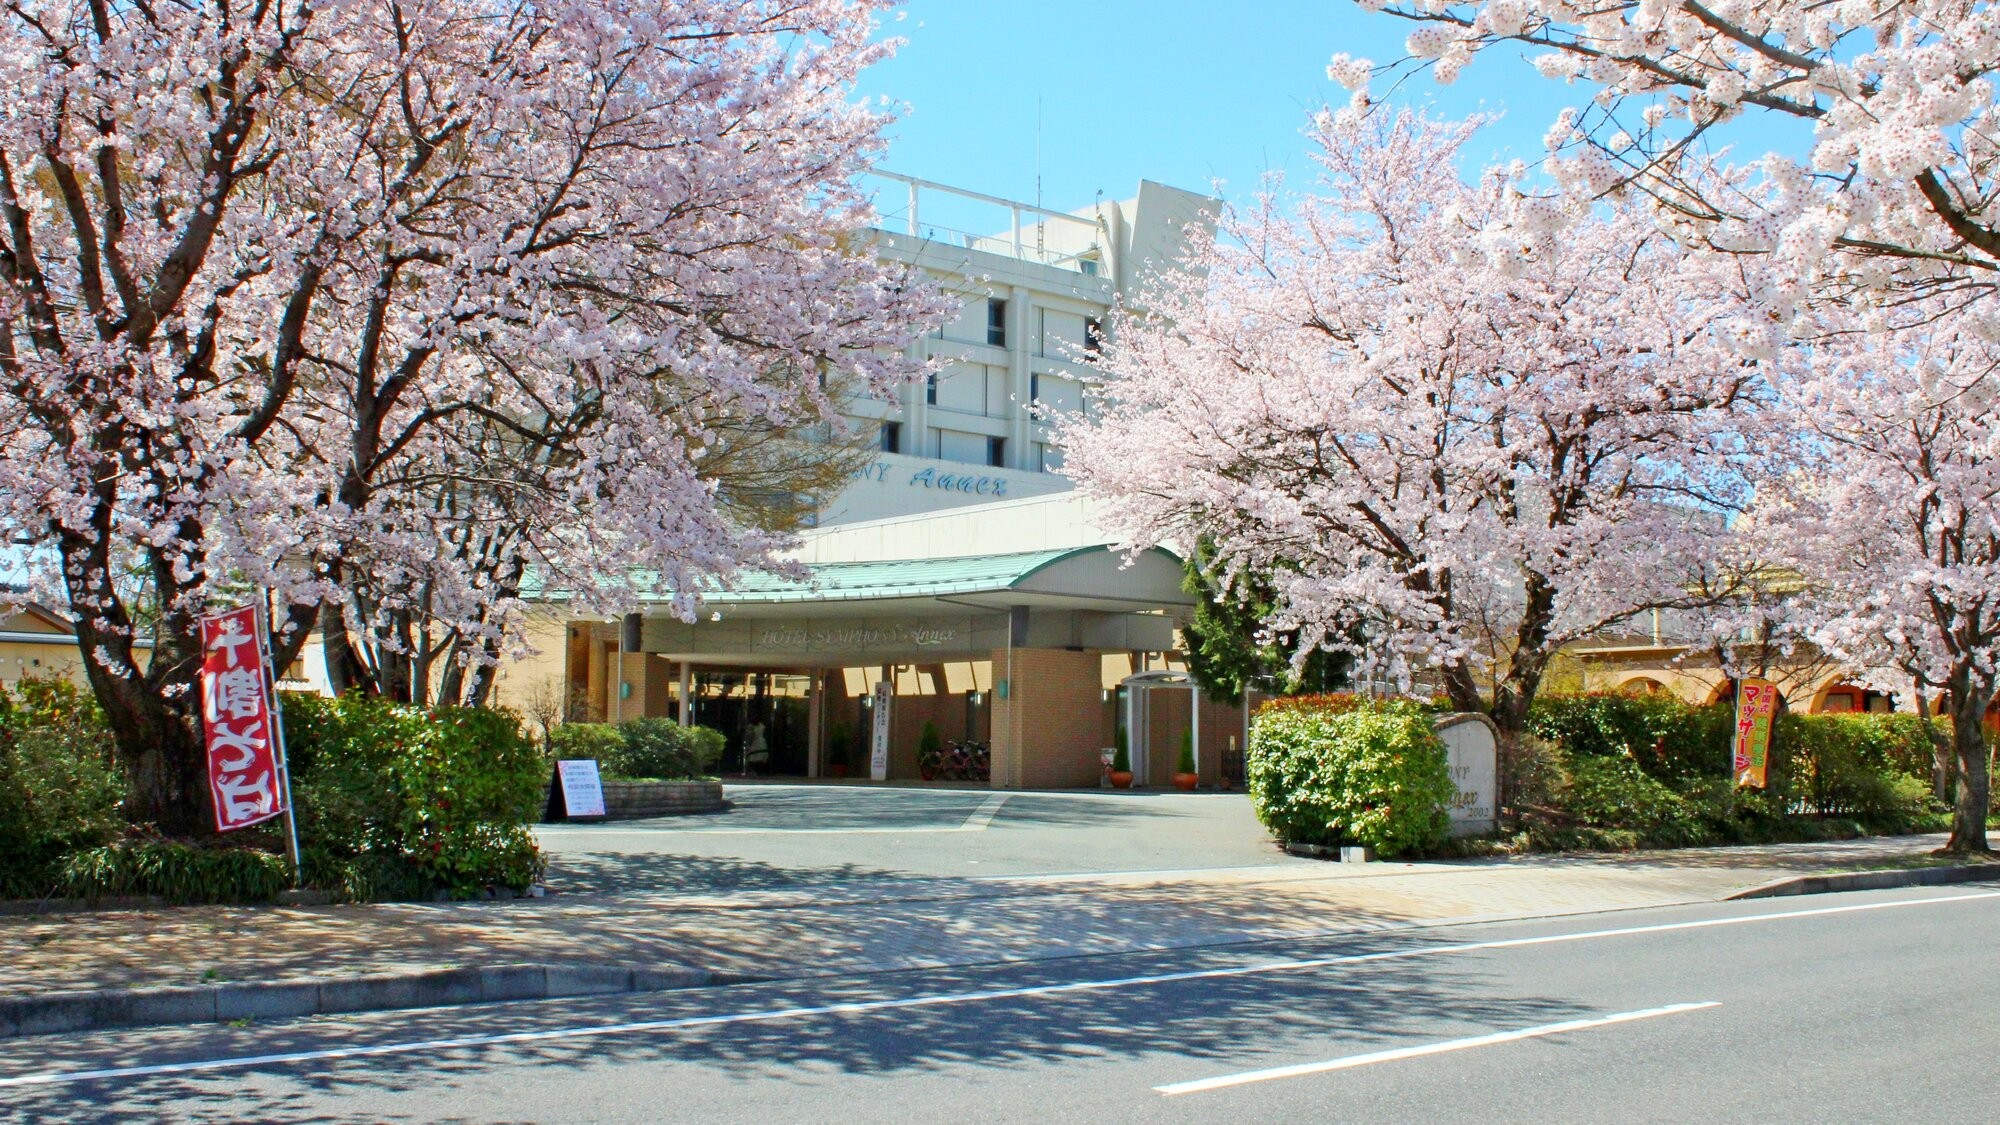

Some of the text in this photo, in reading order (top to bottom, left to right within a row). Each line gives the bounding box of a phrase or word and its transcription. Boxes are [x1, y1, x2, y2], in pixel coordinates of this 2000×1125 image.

[910, 467, 1008, 497] Annex
[762, 627, 811, 645] HOTEL
[1735, 685, 1761, 772] マッサージ
[1468, 807, 1489, 817] 2002
